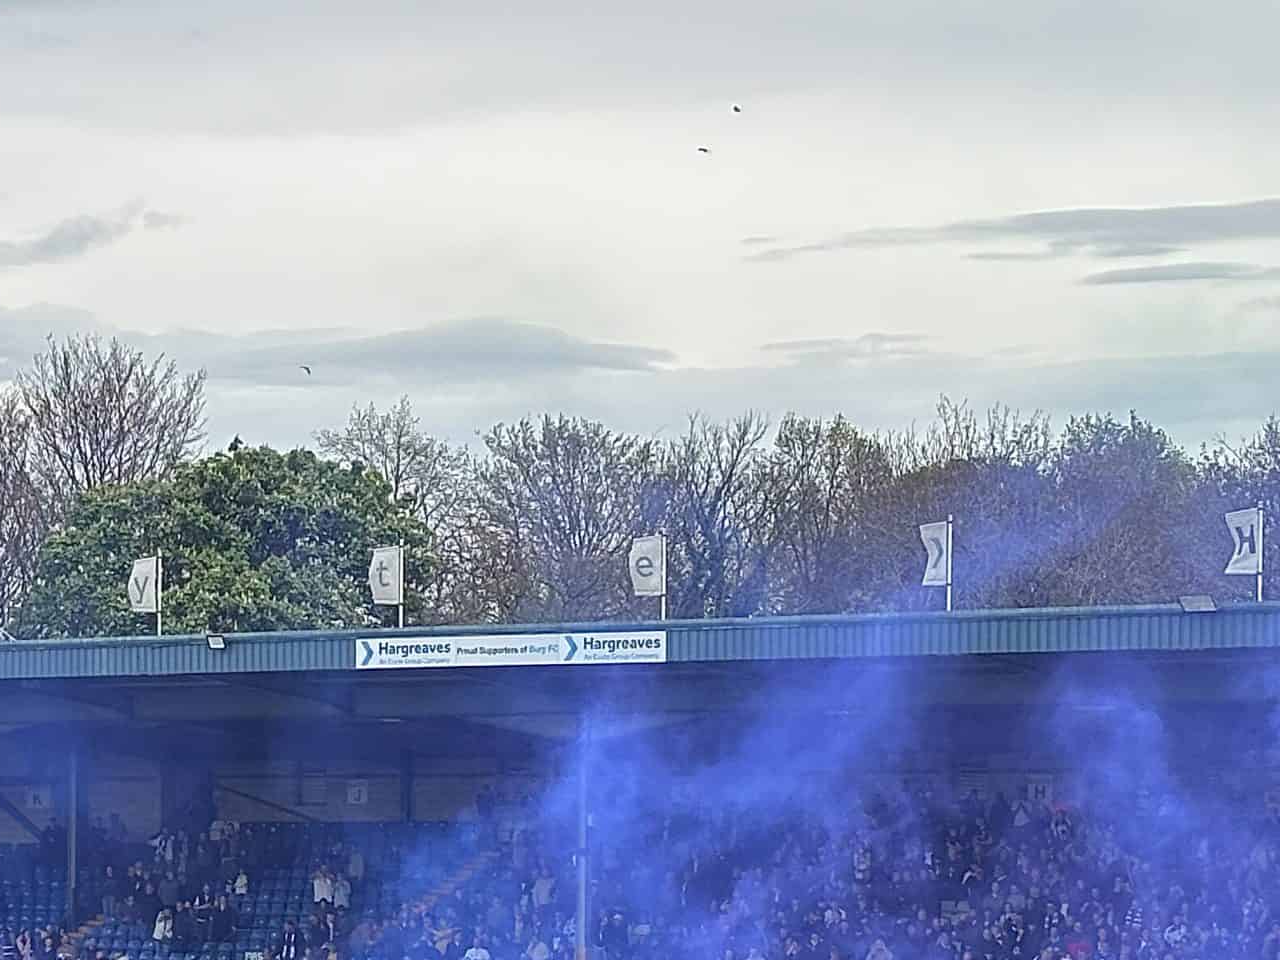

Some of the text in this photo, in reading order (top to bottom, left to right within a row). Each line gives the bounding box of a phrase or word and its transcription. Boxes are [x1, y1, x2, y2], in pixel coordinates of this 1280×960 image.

[375, 561, 389, 587] t
[636, 556, 653, 577] e
[378, 642, 452, 657] Hargreaves
[583, 637, 661, 653] Hargreaves
